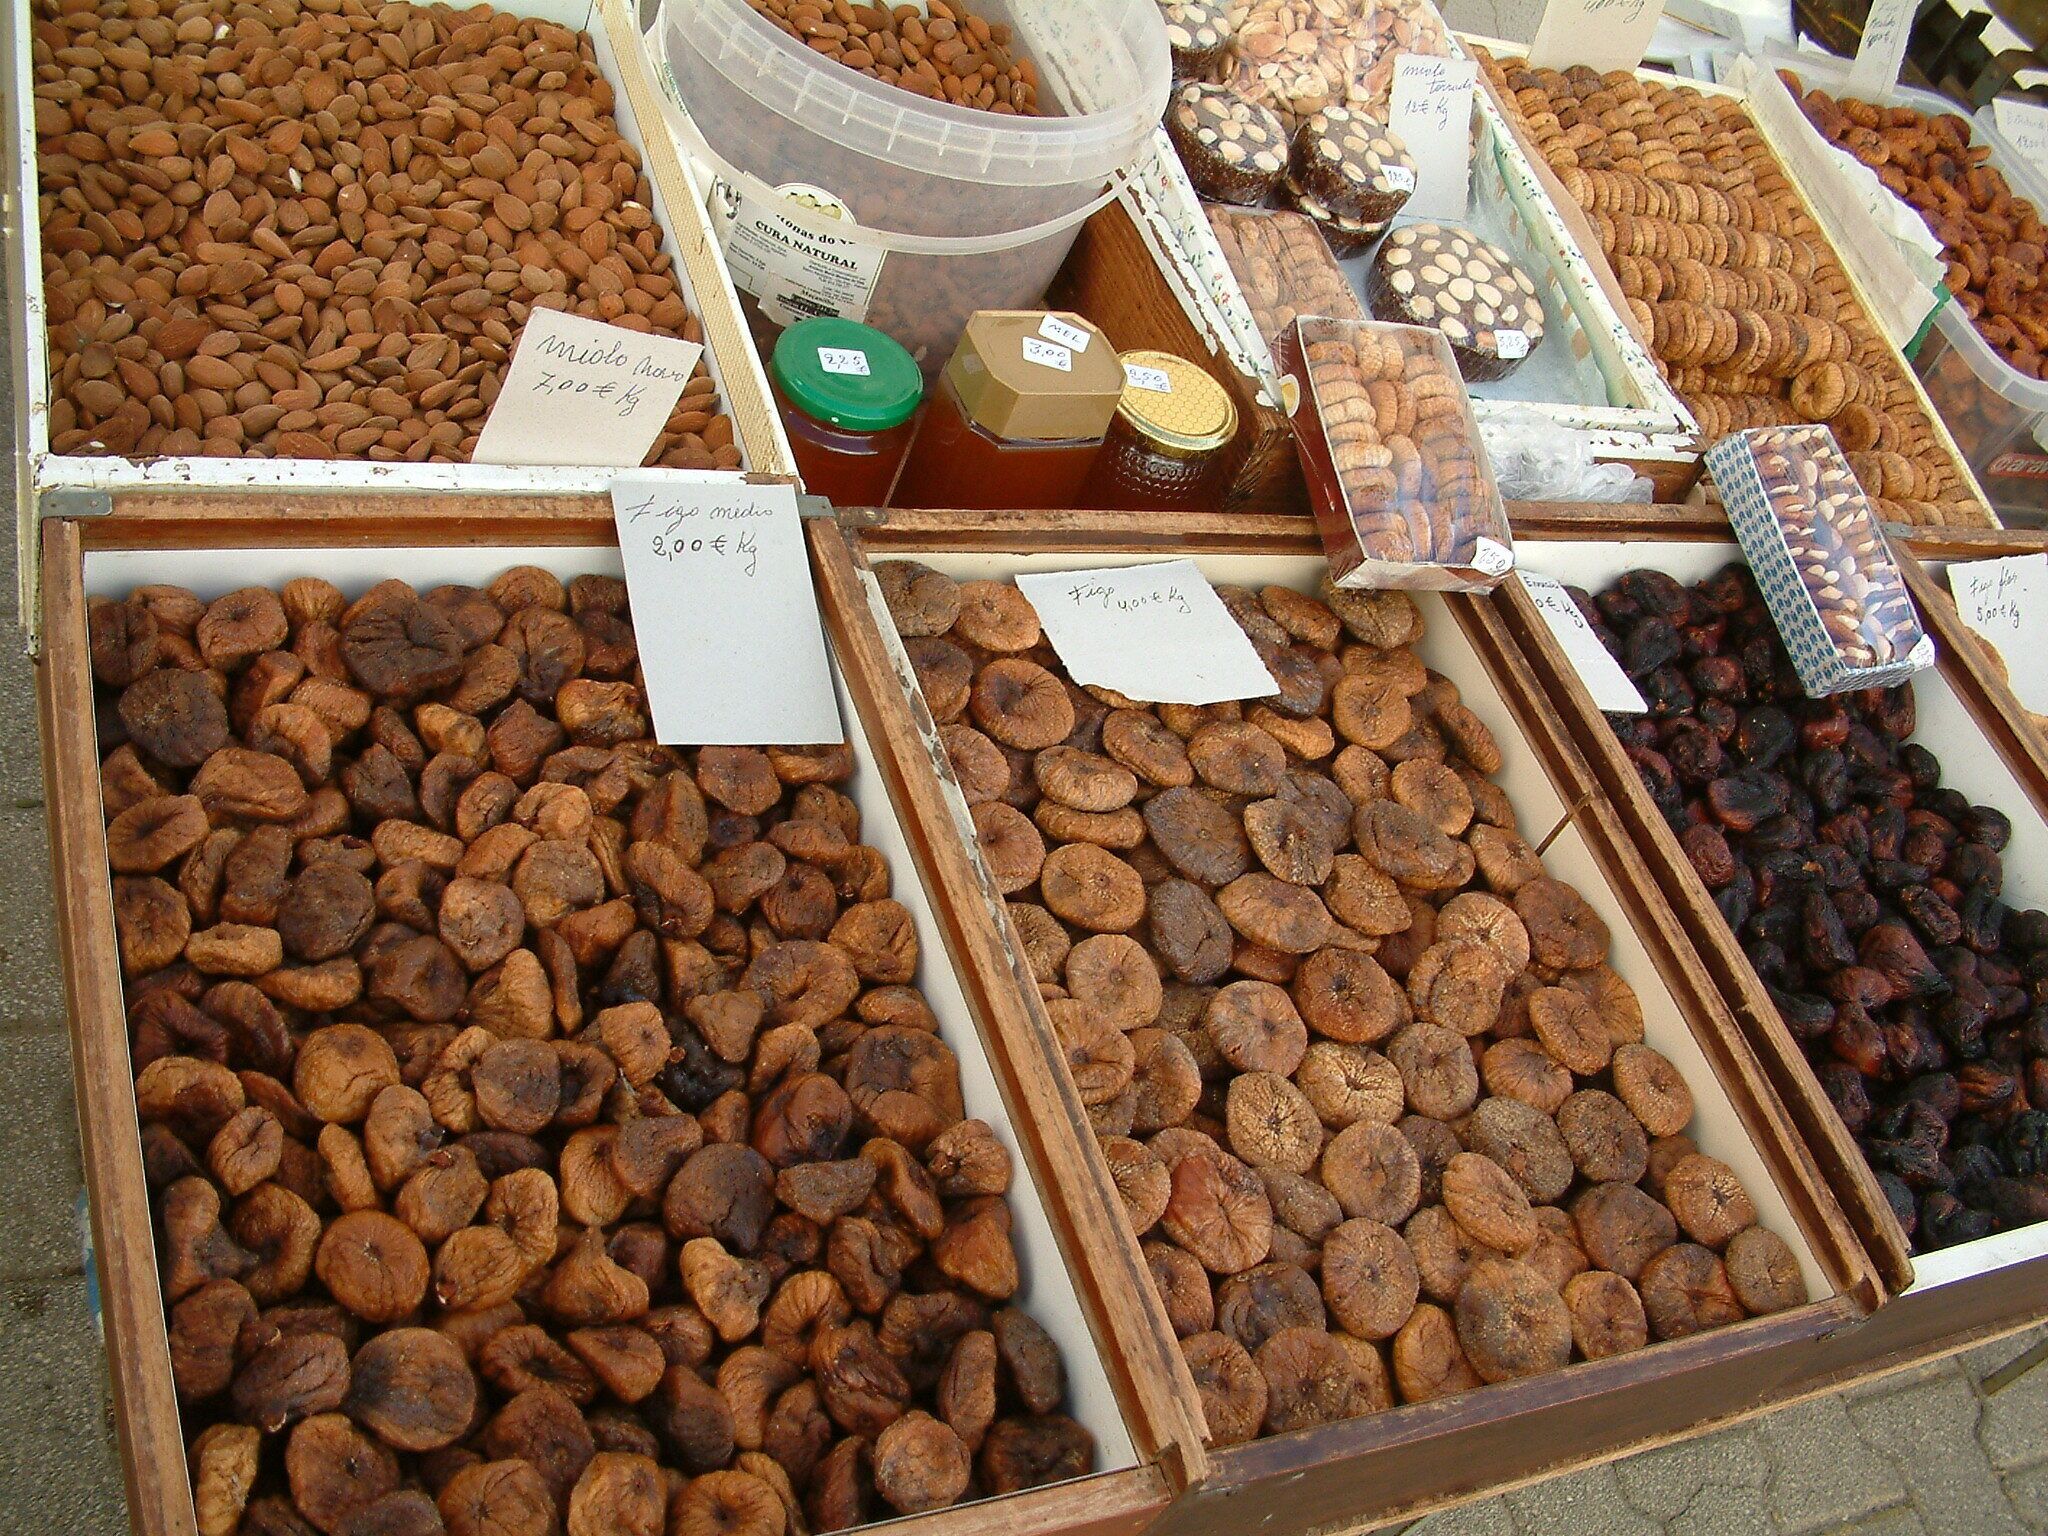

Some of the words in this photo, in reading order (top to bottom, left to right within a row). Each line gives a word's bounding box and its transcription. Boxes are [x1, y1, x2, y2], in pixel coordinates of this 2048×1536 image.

[755, 220, 791, 246] CURA
[792, 239, 859, 271] NATURAL
[818, 234, 836, 246] do
[1048, 324, 1081, 344] MEL
[615, 383, 648, 417] Kg
[736, 531, 758, 577] Kg
[1168, 586, 1192, 614] Kg
